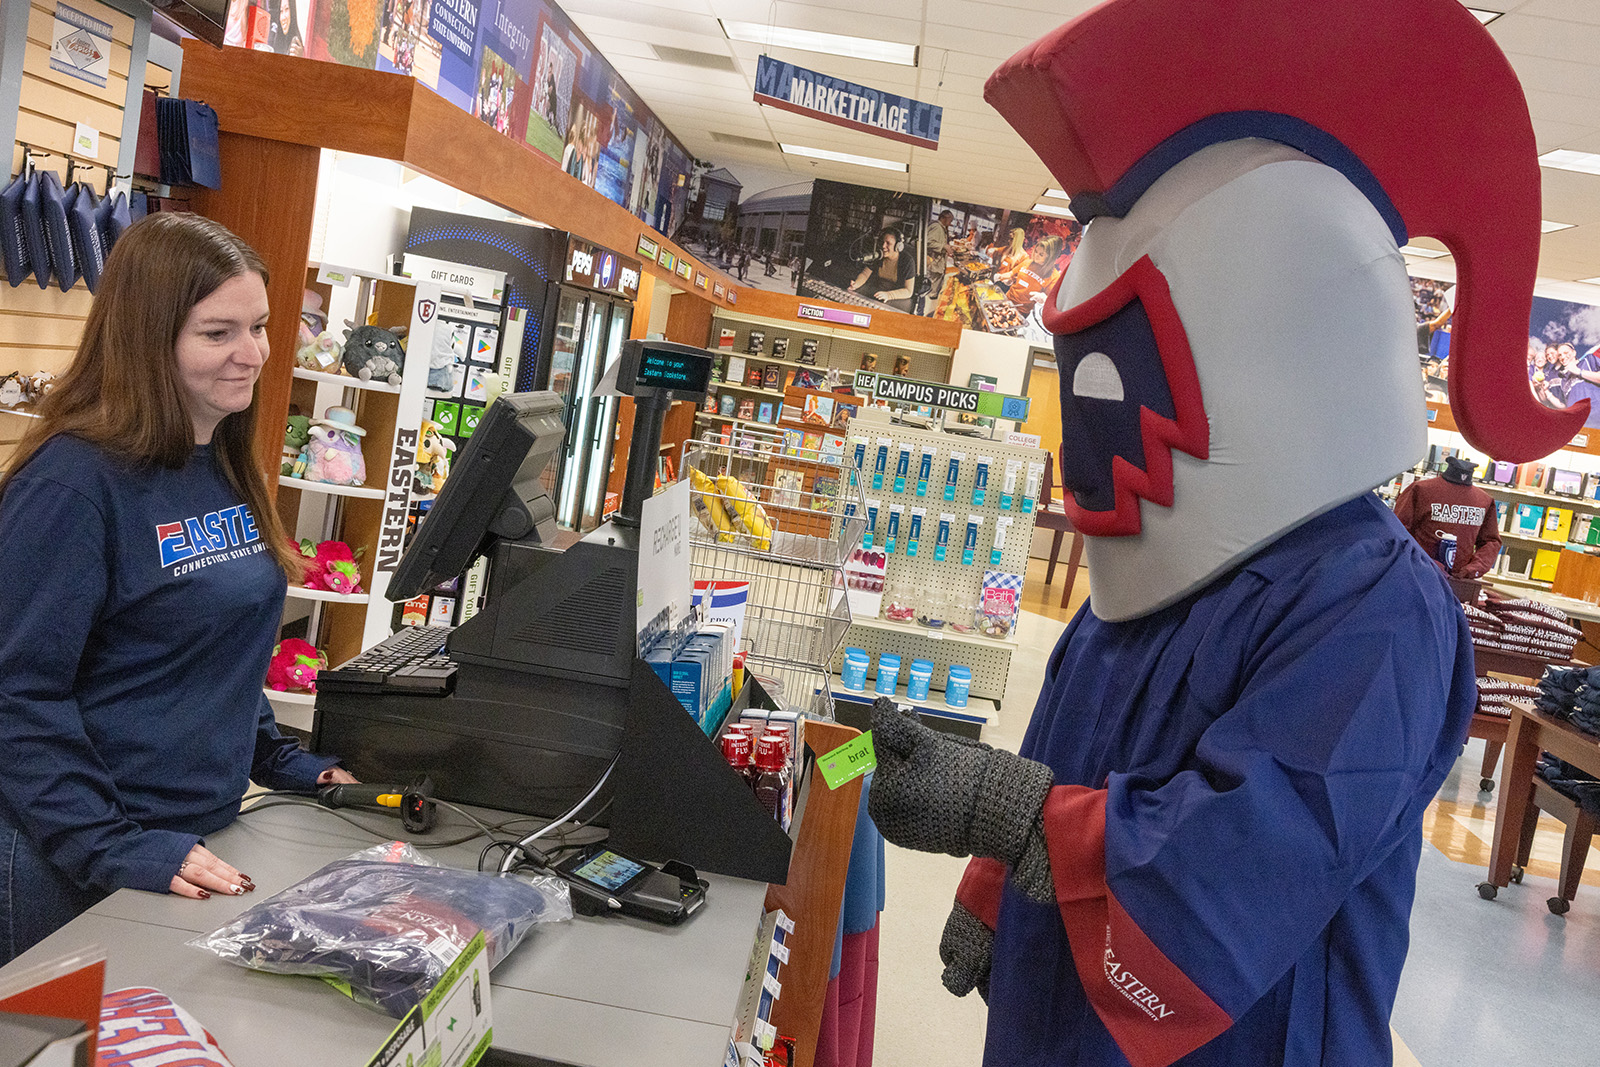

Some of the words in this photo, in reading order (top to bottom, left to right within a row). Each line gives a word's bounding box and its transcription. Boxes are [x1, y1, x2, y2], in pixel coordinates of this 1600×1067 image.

[435, 2, 475, 42] CONNECTICUT
[494, 1, 530, 60] Integrity
[432, 18, 448, 38] STATE
[446, 30, 473, 57] UNIVERSITY
[790, 77, 909, 134] MARKETPLACE
[571, 249, 594, 276] PEPSI
[431, 269, 448, 281] GIFT
[449, 273, 475, 287] CARDS
[422, 303, 431, 318] E
[802, 307, 824, 317] FICTION
[504, 356, 513, 378] GIFT
[643, 368, 663, 378] Eastern
[646, 356, 665, 367] Welcome
[673, 361, 685, 369] your
[857, 374, 876, 388] HEA
[878, 379, 934, 404] CAMPUS
[937, 389, 978, 410] PICKS
[1008, 434, 1037, 445] COLLEGE
[377, 428, 418, 574] EASTERN
[156, 503, 260, 568] EASTE
[173, 553, 231, 577] CONNECTICUT
[230, 548, 251, 560] STATE
[252, 542, 269, 553] UNI
[468, 574, 479, 594] GIFT
[985, 589, 1014, 602] Bath
[735, 747, 748, 755] FLU
[847, 746, 870, 763] brat
[1105, 948, 1175, 1019] EASTERN
[1120, 988, 1134, 1003] STATE
[1132, 999, 1160, 1022] UNIVERSITY
